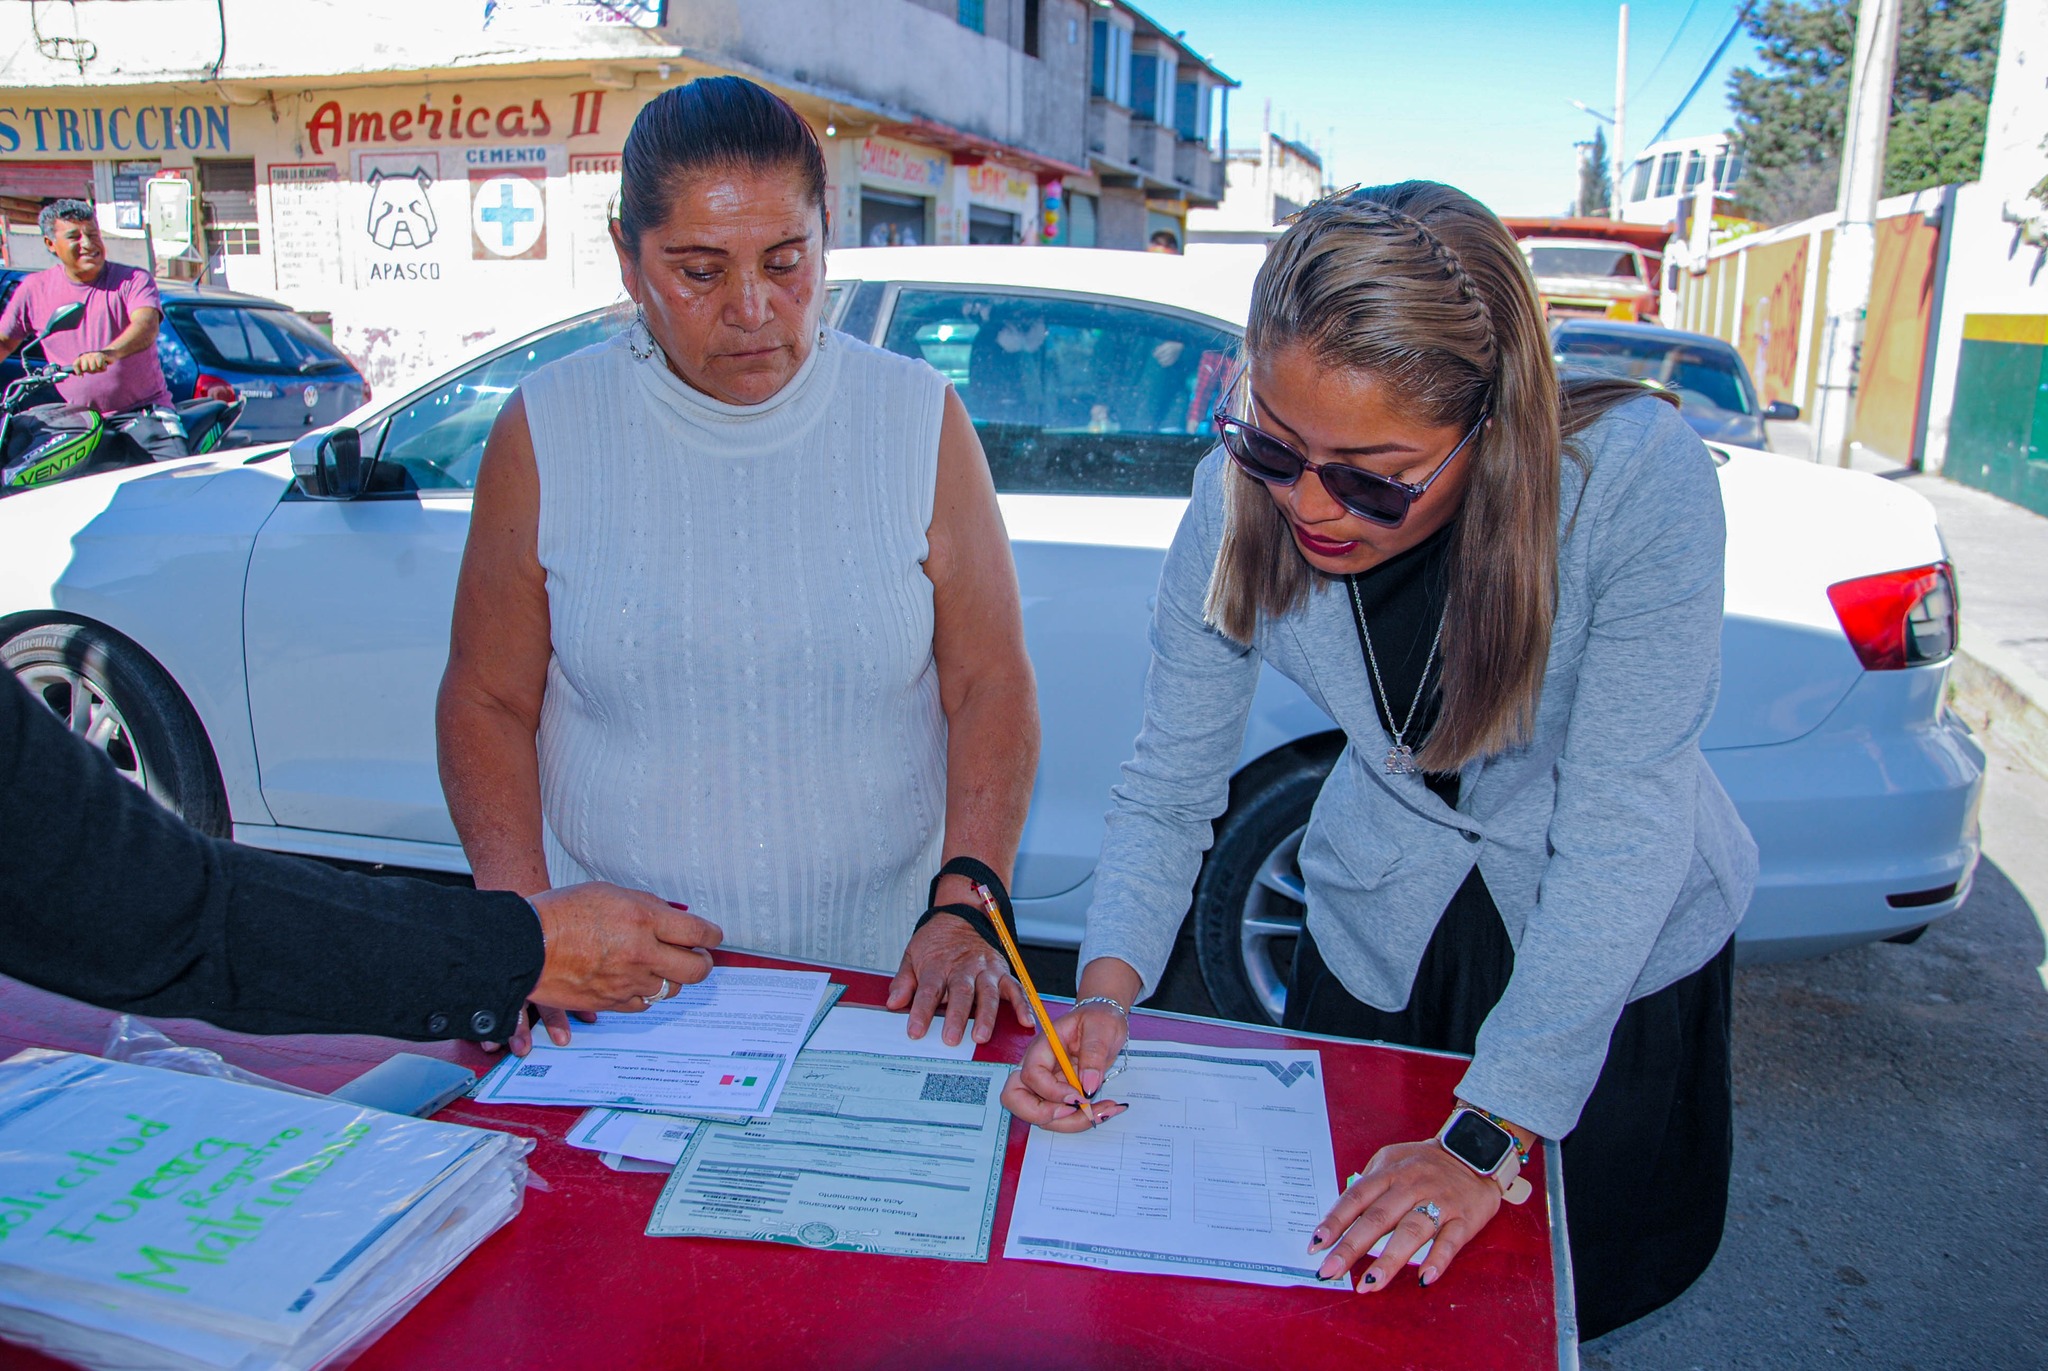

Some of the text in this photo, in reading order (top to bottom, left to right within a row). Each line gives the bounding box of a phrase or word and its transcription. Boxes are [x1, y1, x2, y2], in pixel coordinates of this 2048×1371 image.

[305, 94, 551, 155] Americas
[466, 148, 546, 163] CEMENTO
[370, 262, 440, 280] APASCO
[20, 445, 86, 486] VENTO
[818, 1192, 868, 1202] Nacimiento
[798, 1200, 918, 1218] Estados Unidos Mexicanos
[1023, 1248, 1109, 1265] EDOMEX
[1090, 1246, 1151, 1258] MATRIMONIO
[1168, 1255, 1216, 1265] REGISTRO
[1233, 1262, 1283, 1272] SOLICITUD
